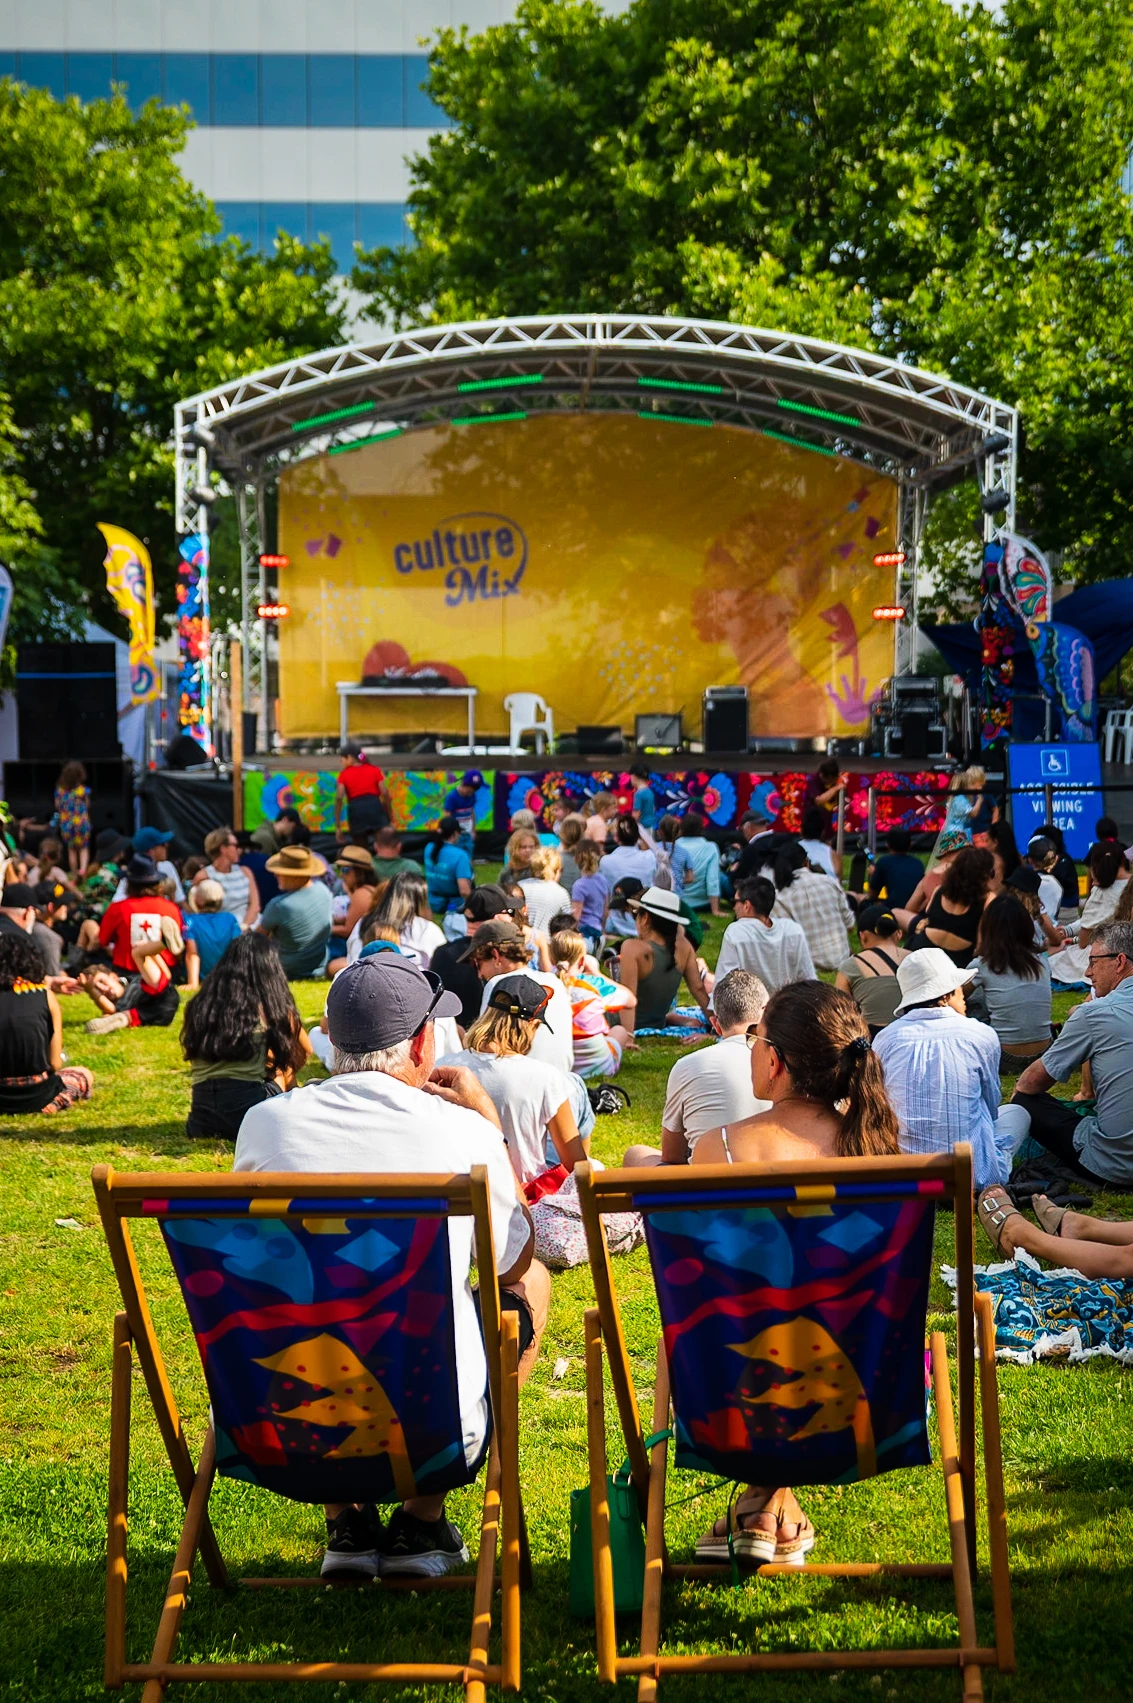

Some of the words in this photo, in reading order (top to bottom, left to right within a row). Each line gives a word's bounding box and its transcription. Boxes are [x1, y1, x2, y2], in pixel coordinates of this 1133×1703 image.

[394, 527, 515, 574] culture
[445, 564, 520, 607] Mix
[1018, 782, 1095, 796] ACCSSIBLE
[1031, 799, 1084, 813] VIWING
[1043, 816, 1075, 831] REA
